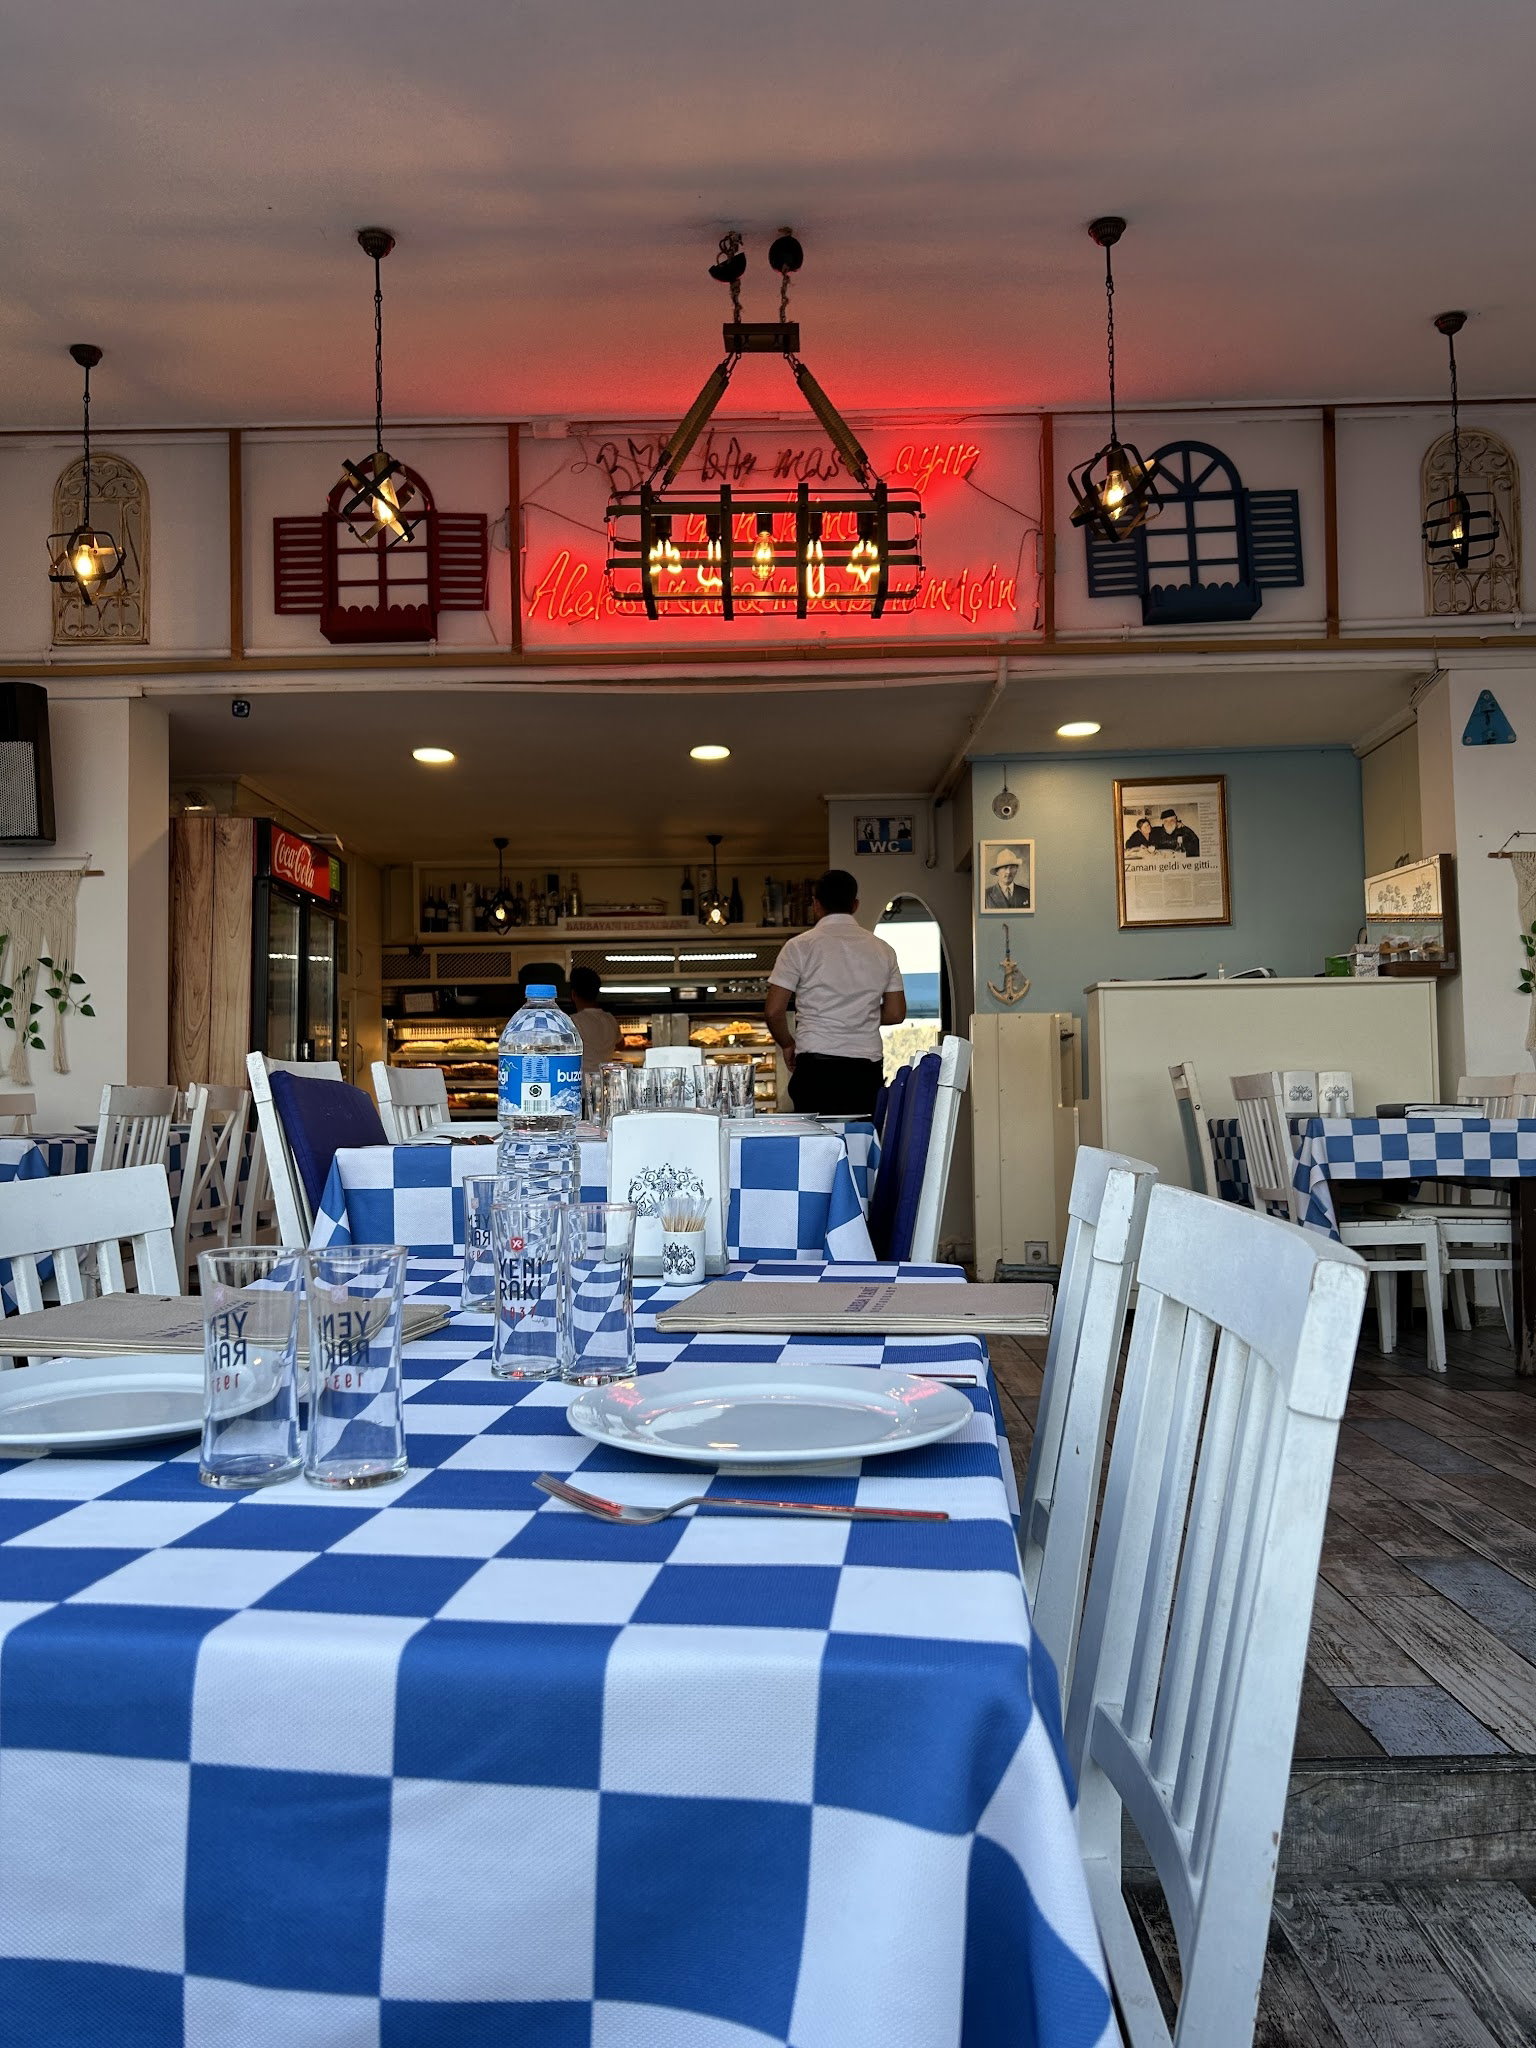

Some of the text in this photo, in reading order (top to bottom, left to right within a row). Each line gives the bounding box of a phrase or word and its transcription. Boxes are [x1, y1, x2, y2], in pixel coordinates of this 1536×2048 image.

[774, 447, 866, 482] mas
[869, 840, 900, 853] WC
[274, 832, 315, 889] Coca-Cola
[1125, 863, 1157, 873] Zamanı
[1159, 861, 1180, 872] geldi
